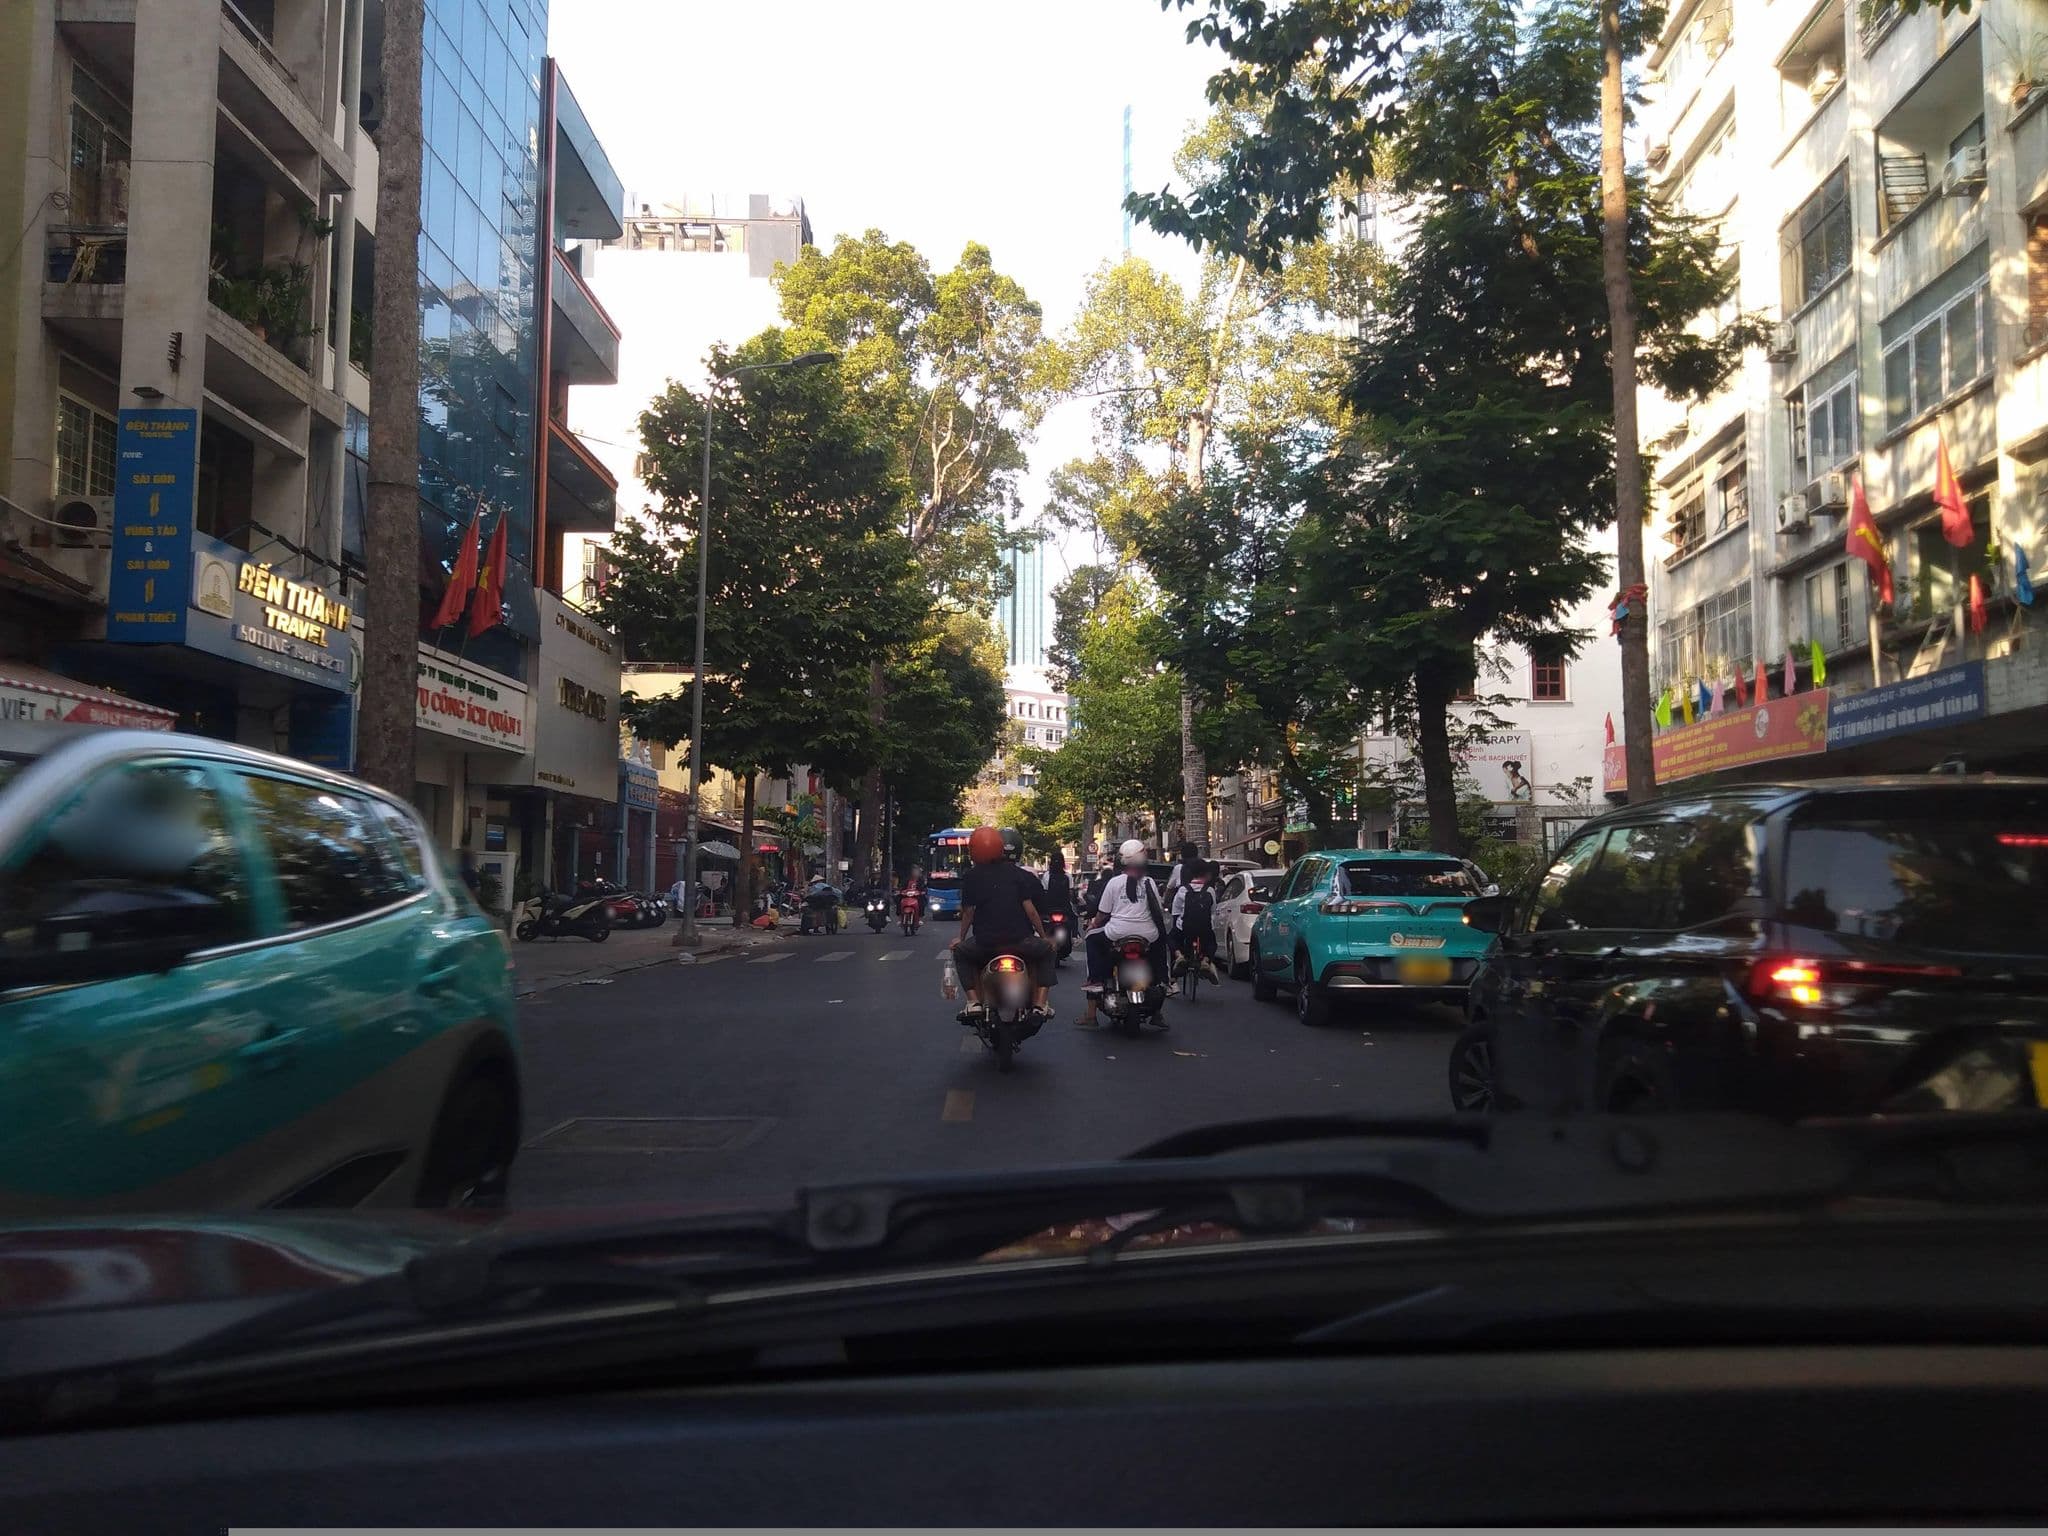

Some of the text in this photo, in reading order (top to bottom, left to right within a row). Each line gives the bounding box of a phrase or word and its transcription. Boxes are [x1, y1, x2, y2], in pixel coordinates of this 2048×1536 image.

[239, 562, 352, 632] BẾN THÀNH
[265, 606, 328, 648] TRAVEL
